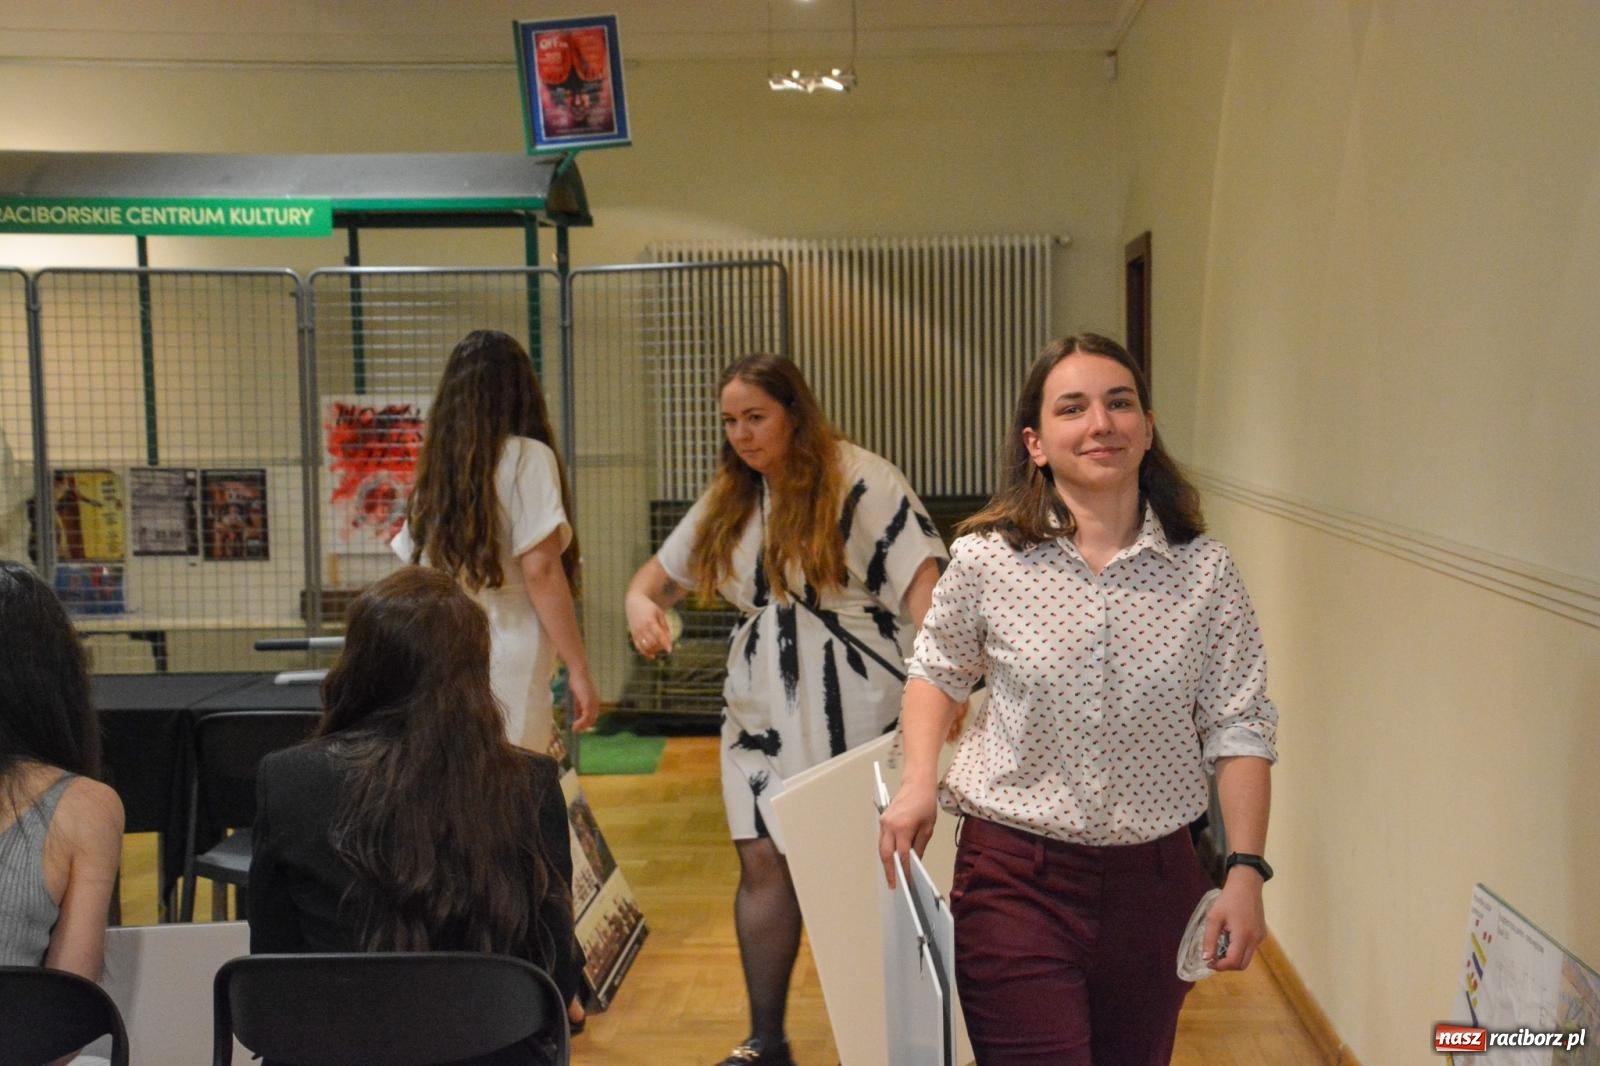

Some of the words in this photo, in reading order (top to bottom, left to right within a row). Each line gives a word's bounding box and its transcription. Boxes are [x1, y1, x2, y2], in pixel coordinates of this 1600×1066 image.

[0, 205, 122, 225] ACIBORSKIE
[126, 205, 226, 226] CENTRUM
[230, 206, 314, 226] KULTURY
